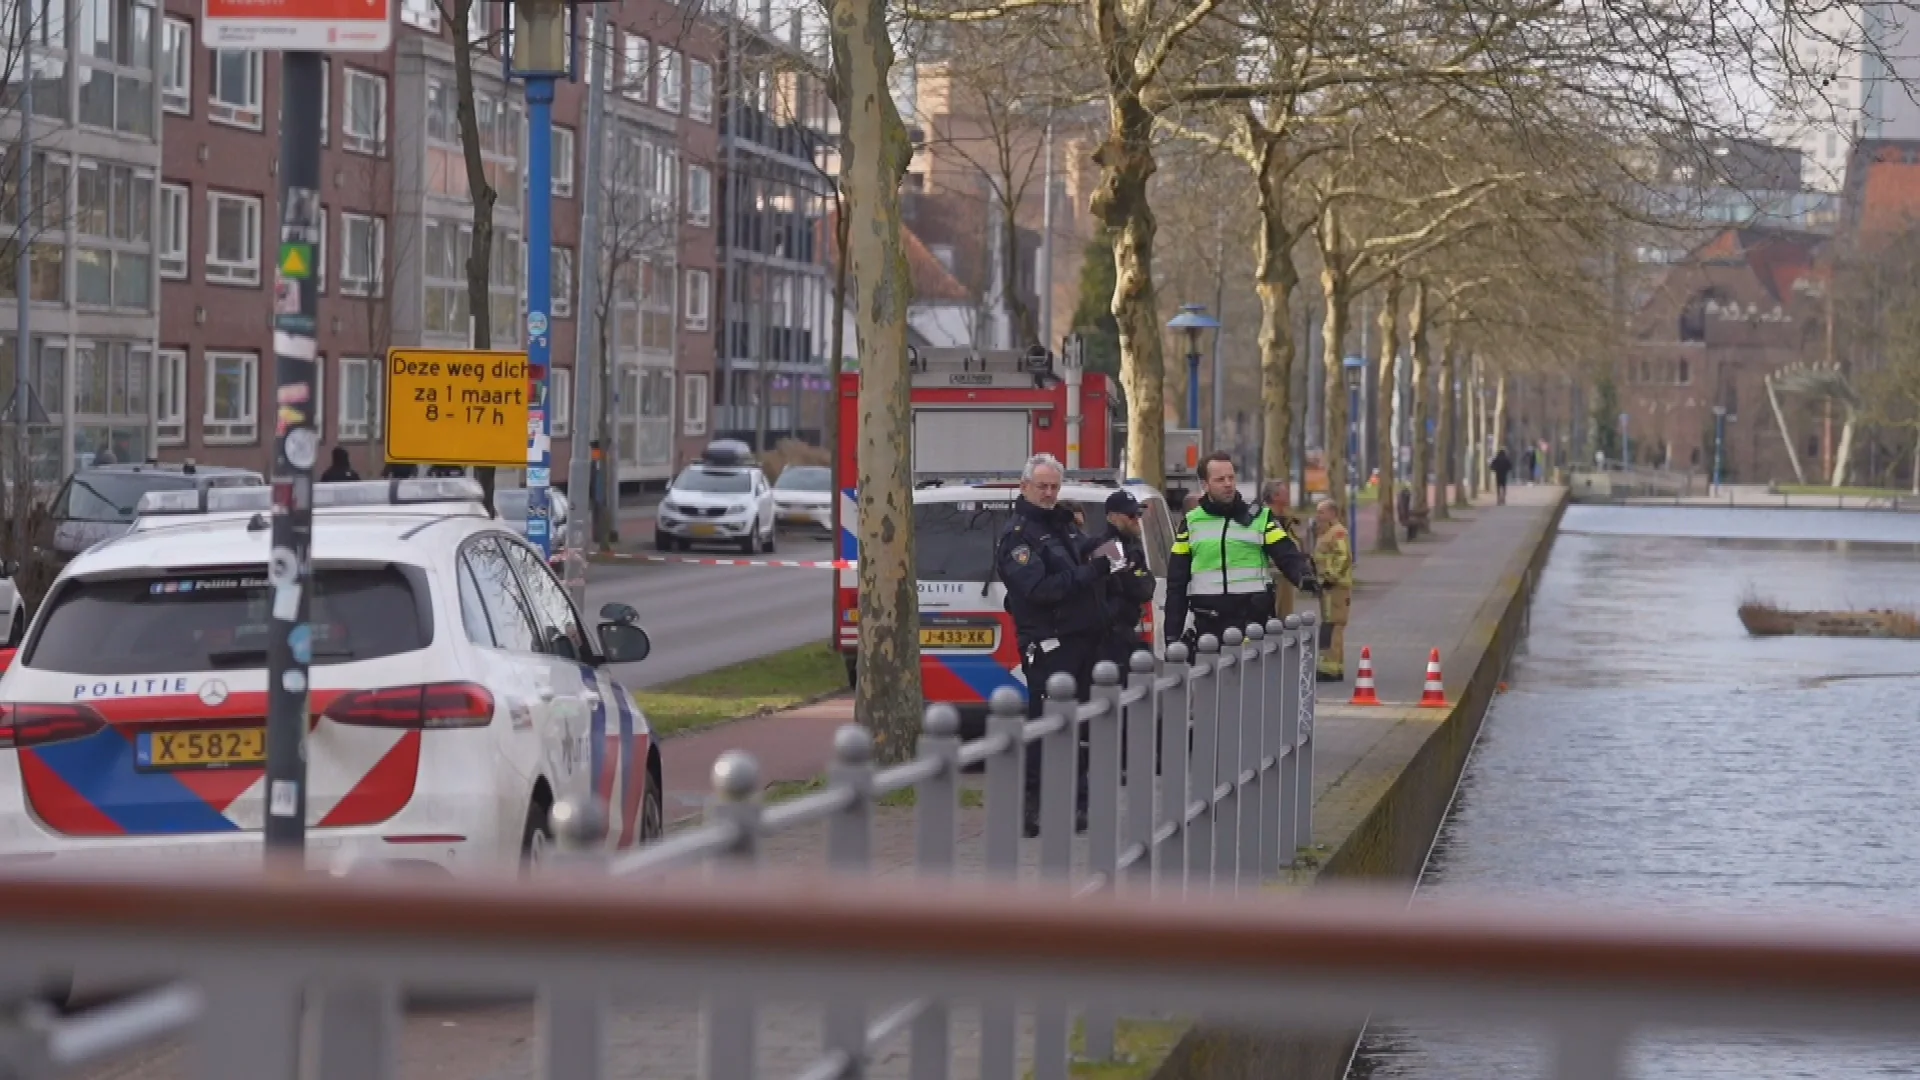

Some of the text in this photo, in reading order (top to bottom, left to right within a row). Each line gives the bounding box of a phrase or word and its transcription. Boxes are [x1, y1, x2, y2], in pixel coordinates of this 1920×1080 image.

[393, 357, 528, 382] Deze weg dich
[414, 385, 522, 405] za 1 maart
[425, 404, 439, 422] 8
[465, 406, 486, 425] 17
[492, 407, 504, 425] h
[917, 583, 964, 593] OLITIE
[924, 631, 986, 643] J-433-XK
[73, 677, 188, 699] POLITIE
[159, 730, 265, 760] X-582-J
